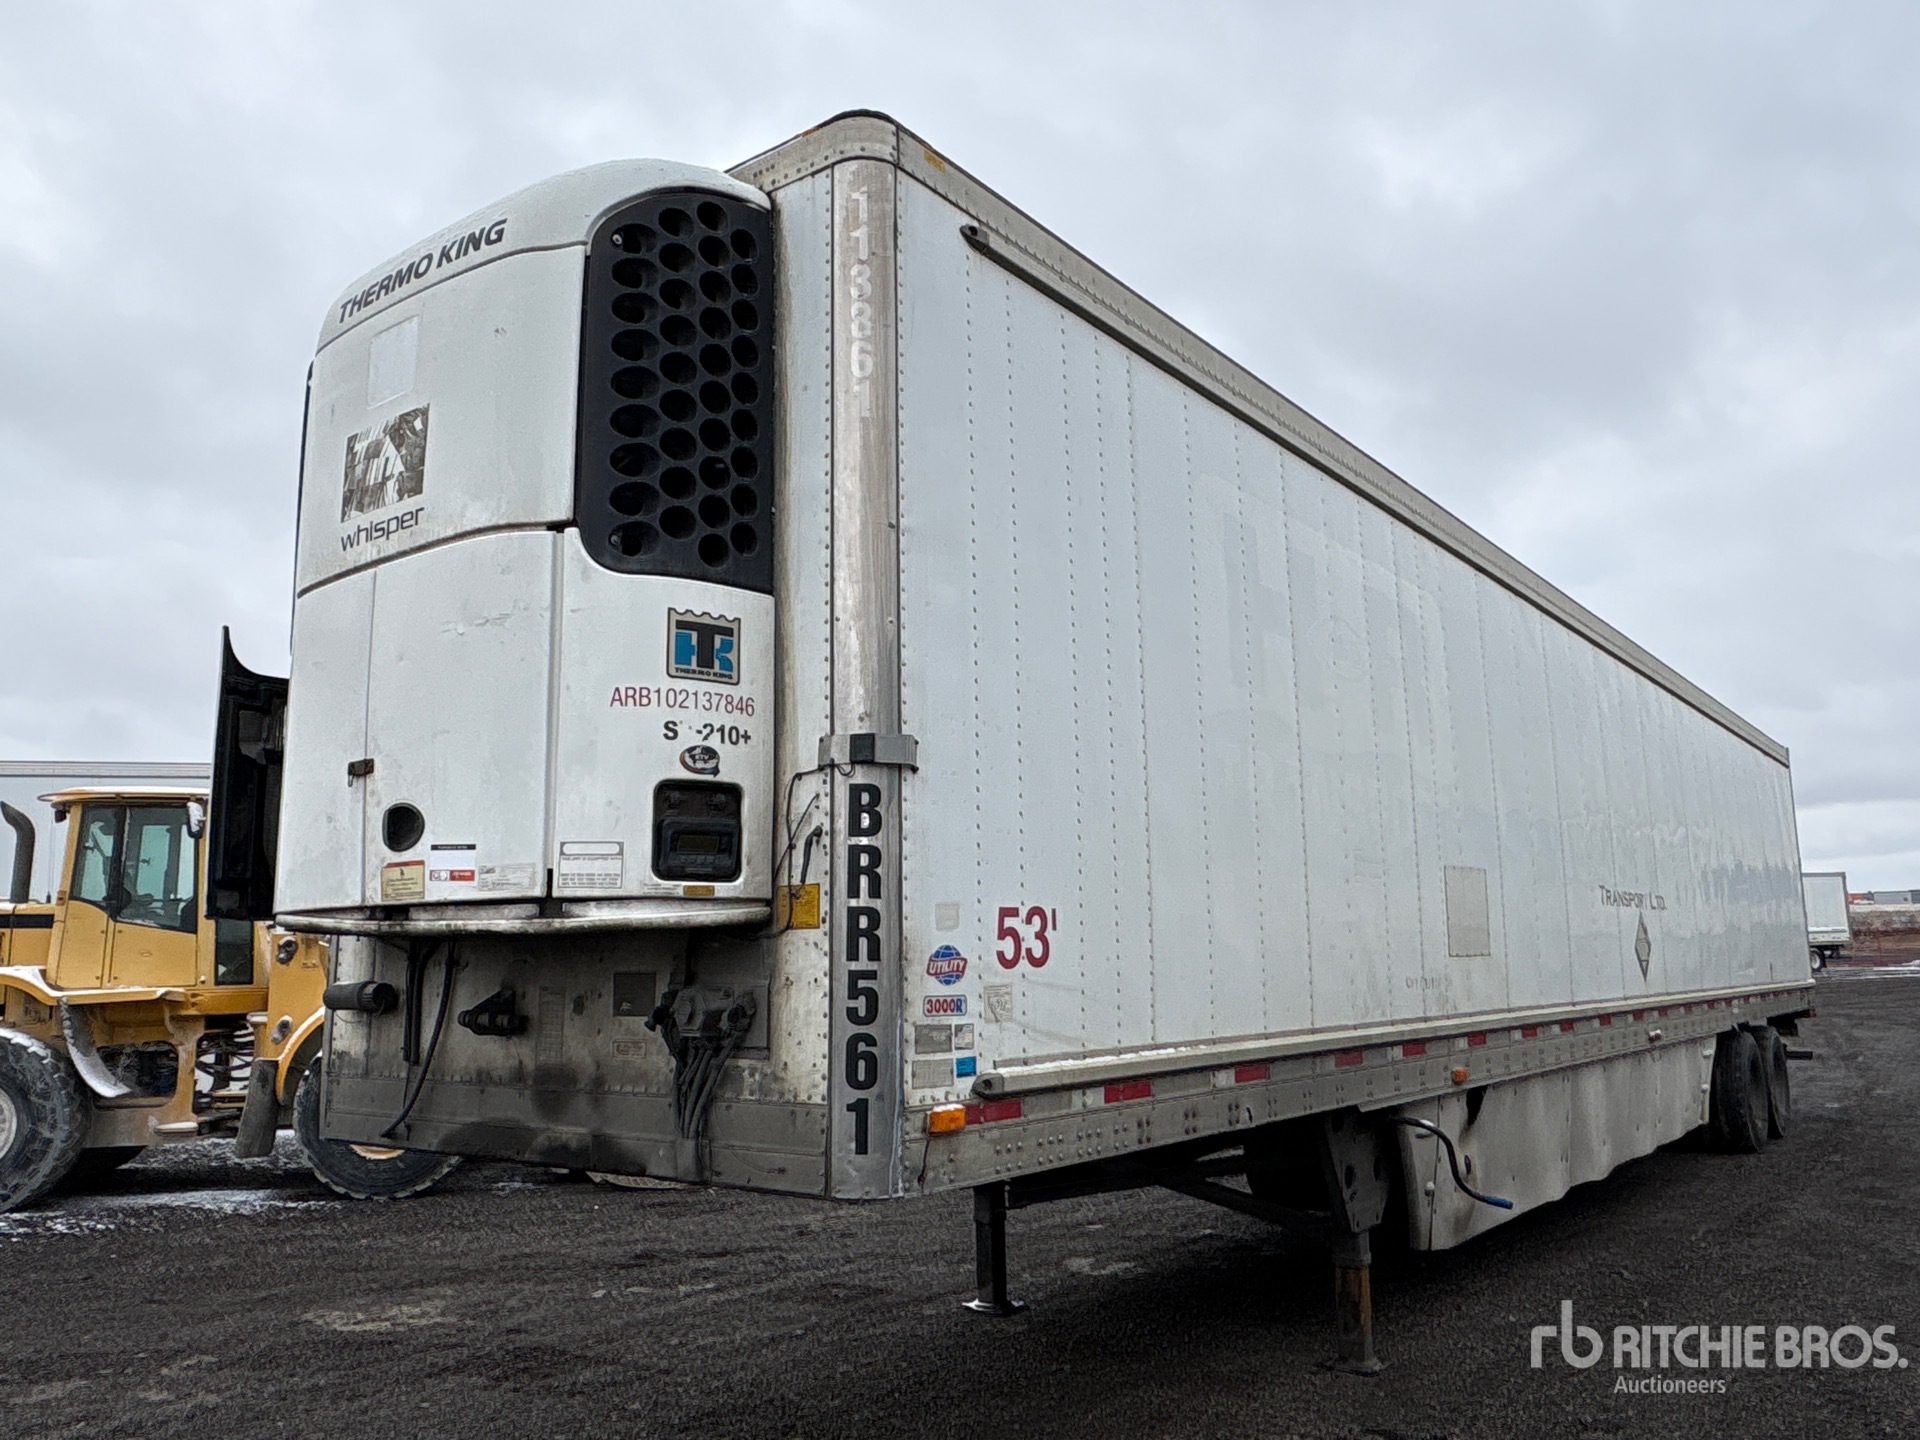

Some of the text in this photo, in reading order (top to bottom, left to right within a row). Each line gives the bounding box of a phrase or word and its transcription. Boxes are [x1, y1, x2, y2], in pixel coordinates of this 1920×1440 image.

[339, 218, 508, 324] THERMO KING
[340, 507, 425, 551] whisper
[675, 667, 733, 680] THERMO KING
[610, 686, 756, 717] ARB102137846
[996, 906, 1057, 969] 53'
[845, 783, 882, 1156] BRR561
[928, 959, 966, 975] UTILITY
[926, 998, 963, 1014] 3000R
